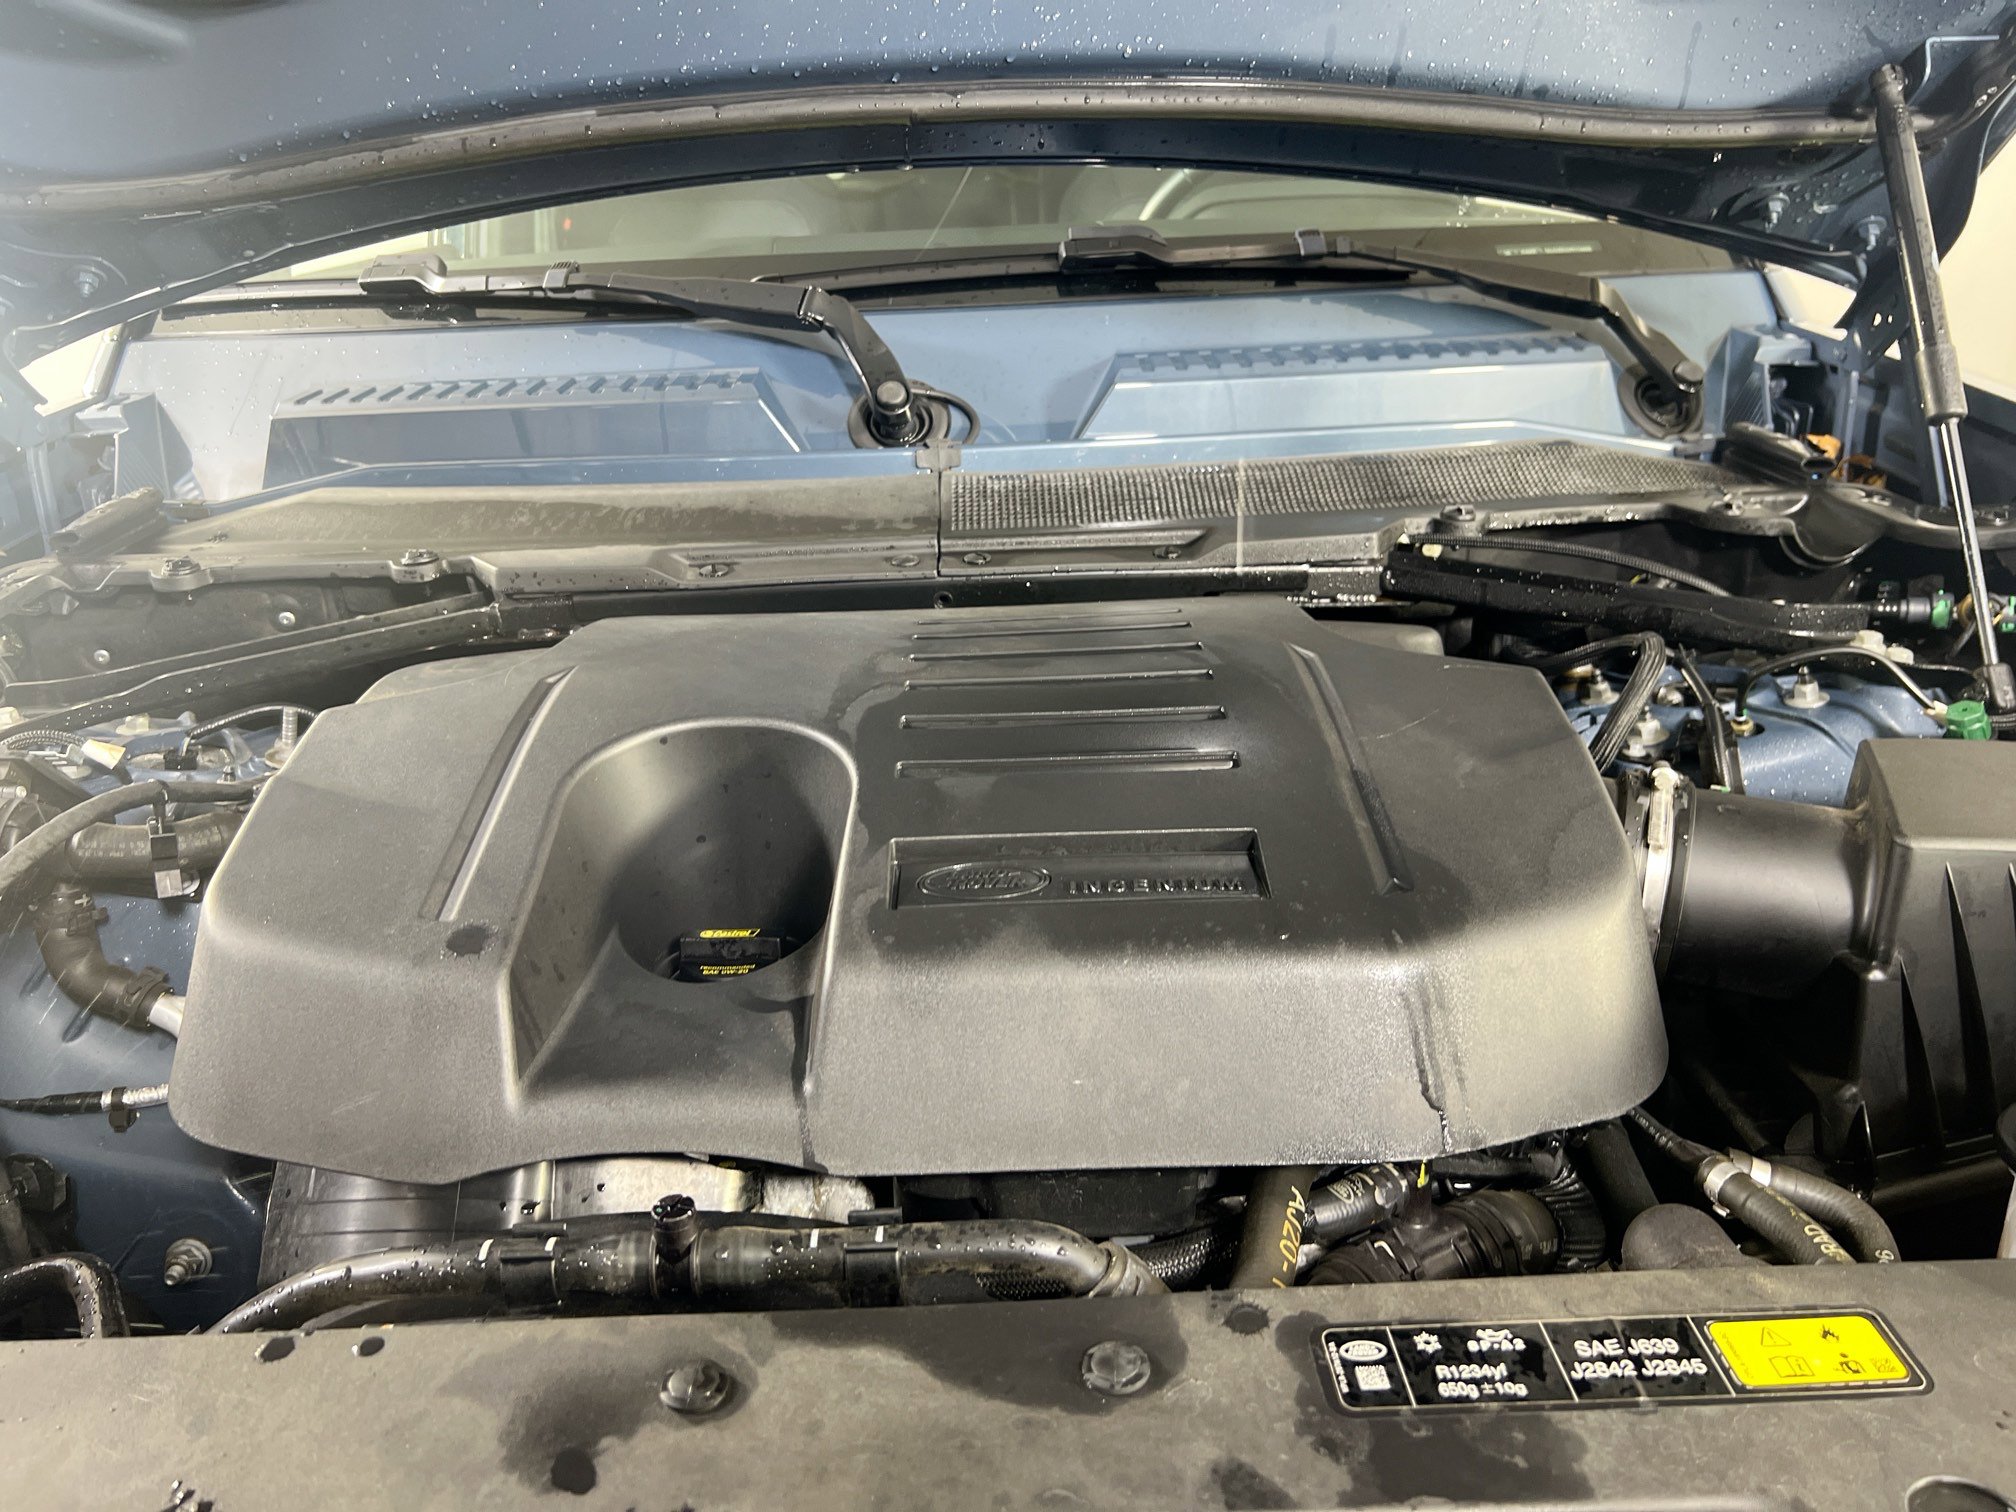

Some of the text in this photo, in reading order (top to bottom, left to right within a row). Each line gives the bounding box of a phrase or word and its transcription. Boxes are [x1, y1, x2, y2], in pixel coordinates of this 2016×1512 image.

[1069, 878, 1244, 895] INGENIUM
[713, 929, 752, 938] Castrol
[1574, 1337, 1679, 1358] SAE J639
[1570, 1357, 1708, 1380] J2842 J2845
[1437, 1381, 1480, 1400] 650g
